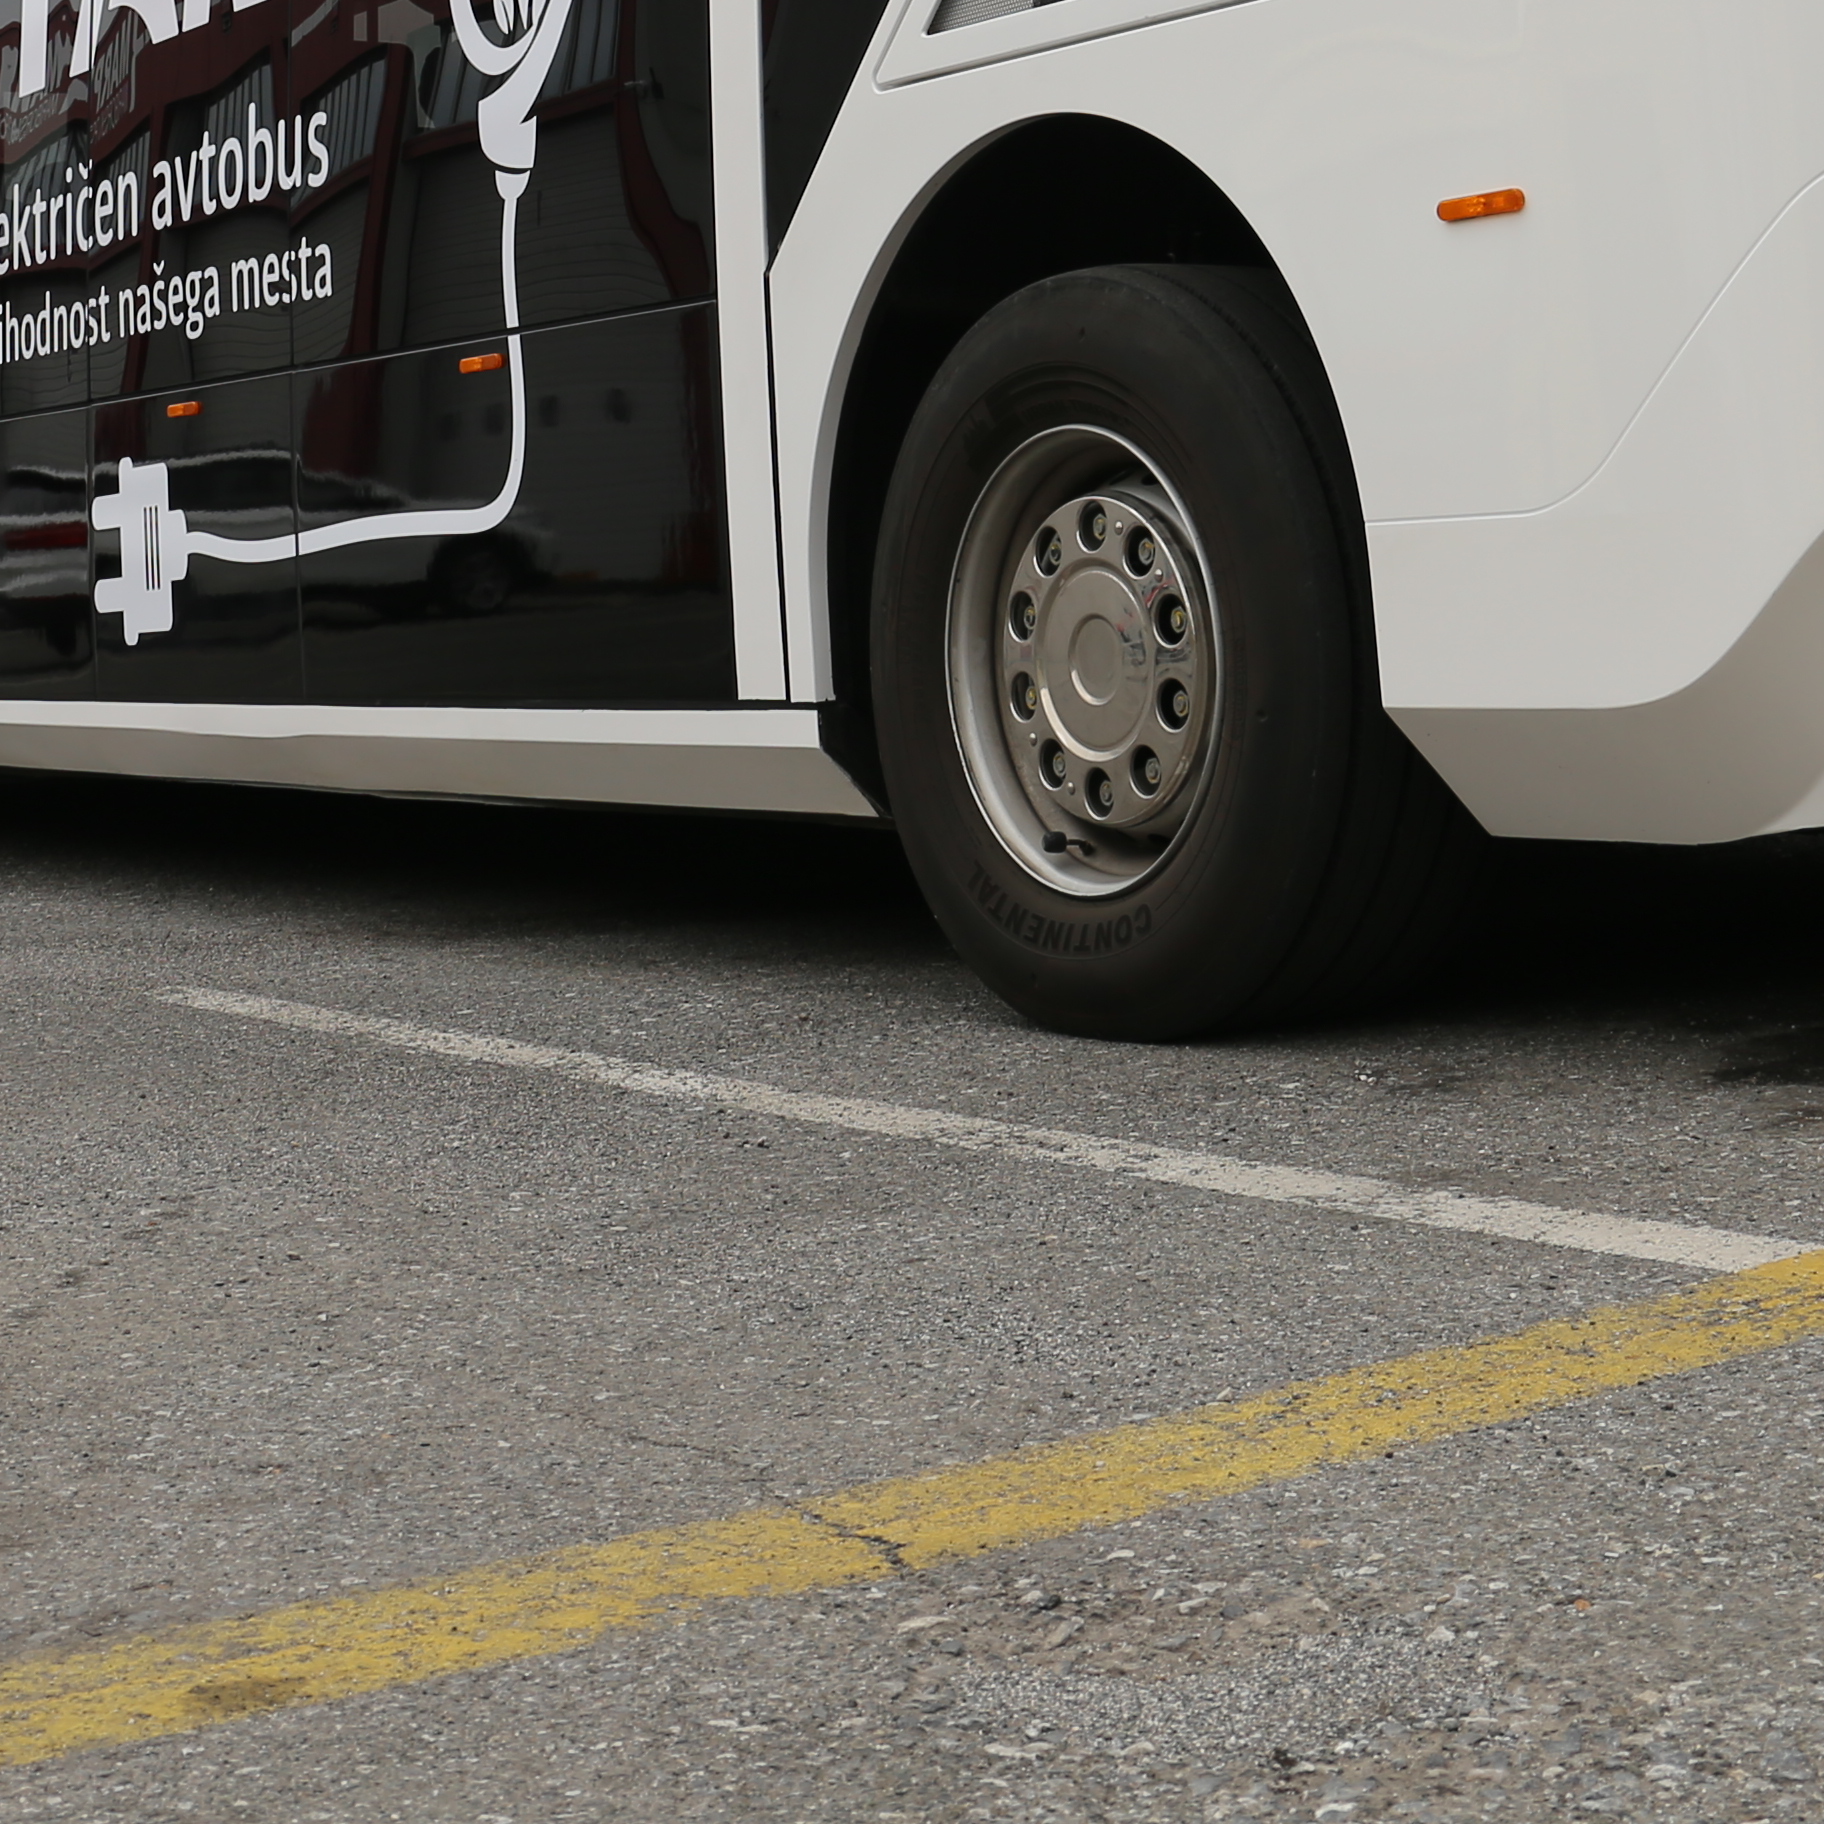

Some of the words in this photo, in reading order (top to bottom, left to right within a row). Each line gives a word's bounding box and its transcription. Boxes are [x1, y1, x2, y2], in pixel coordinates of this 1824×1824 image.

[151, 102, 330, 231] avtobus
[118, 259, 221, 340] našega
[231, 236, 333, 313] mesta
[967, 859, 1152, 953] CONTINENTAL
